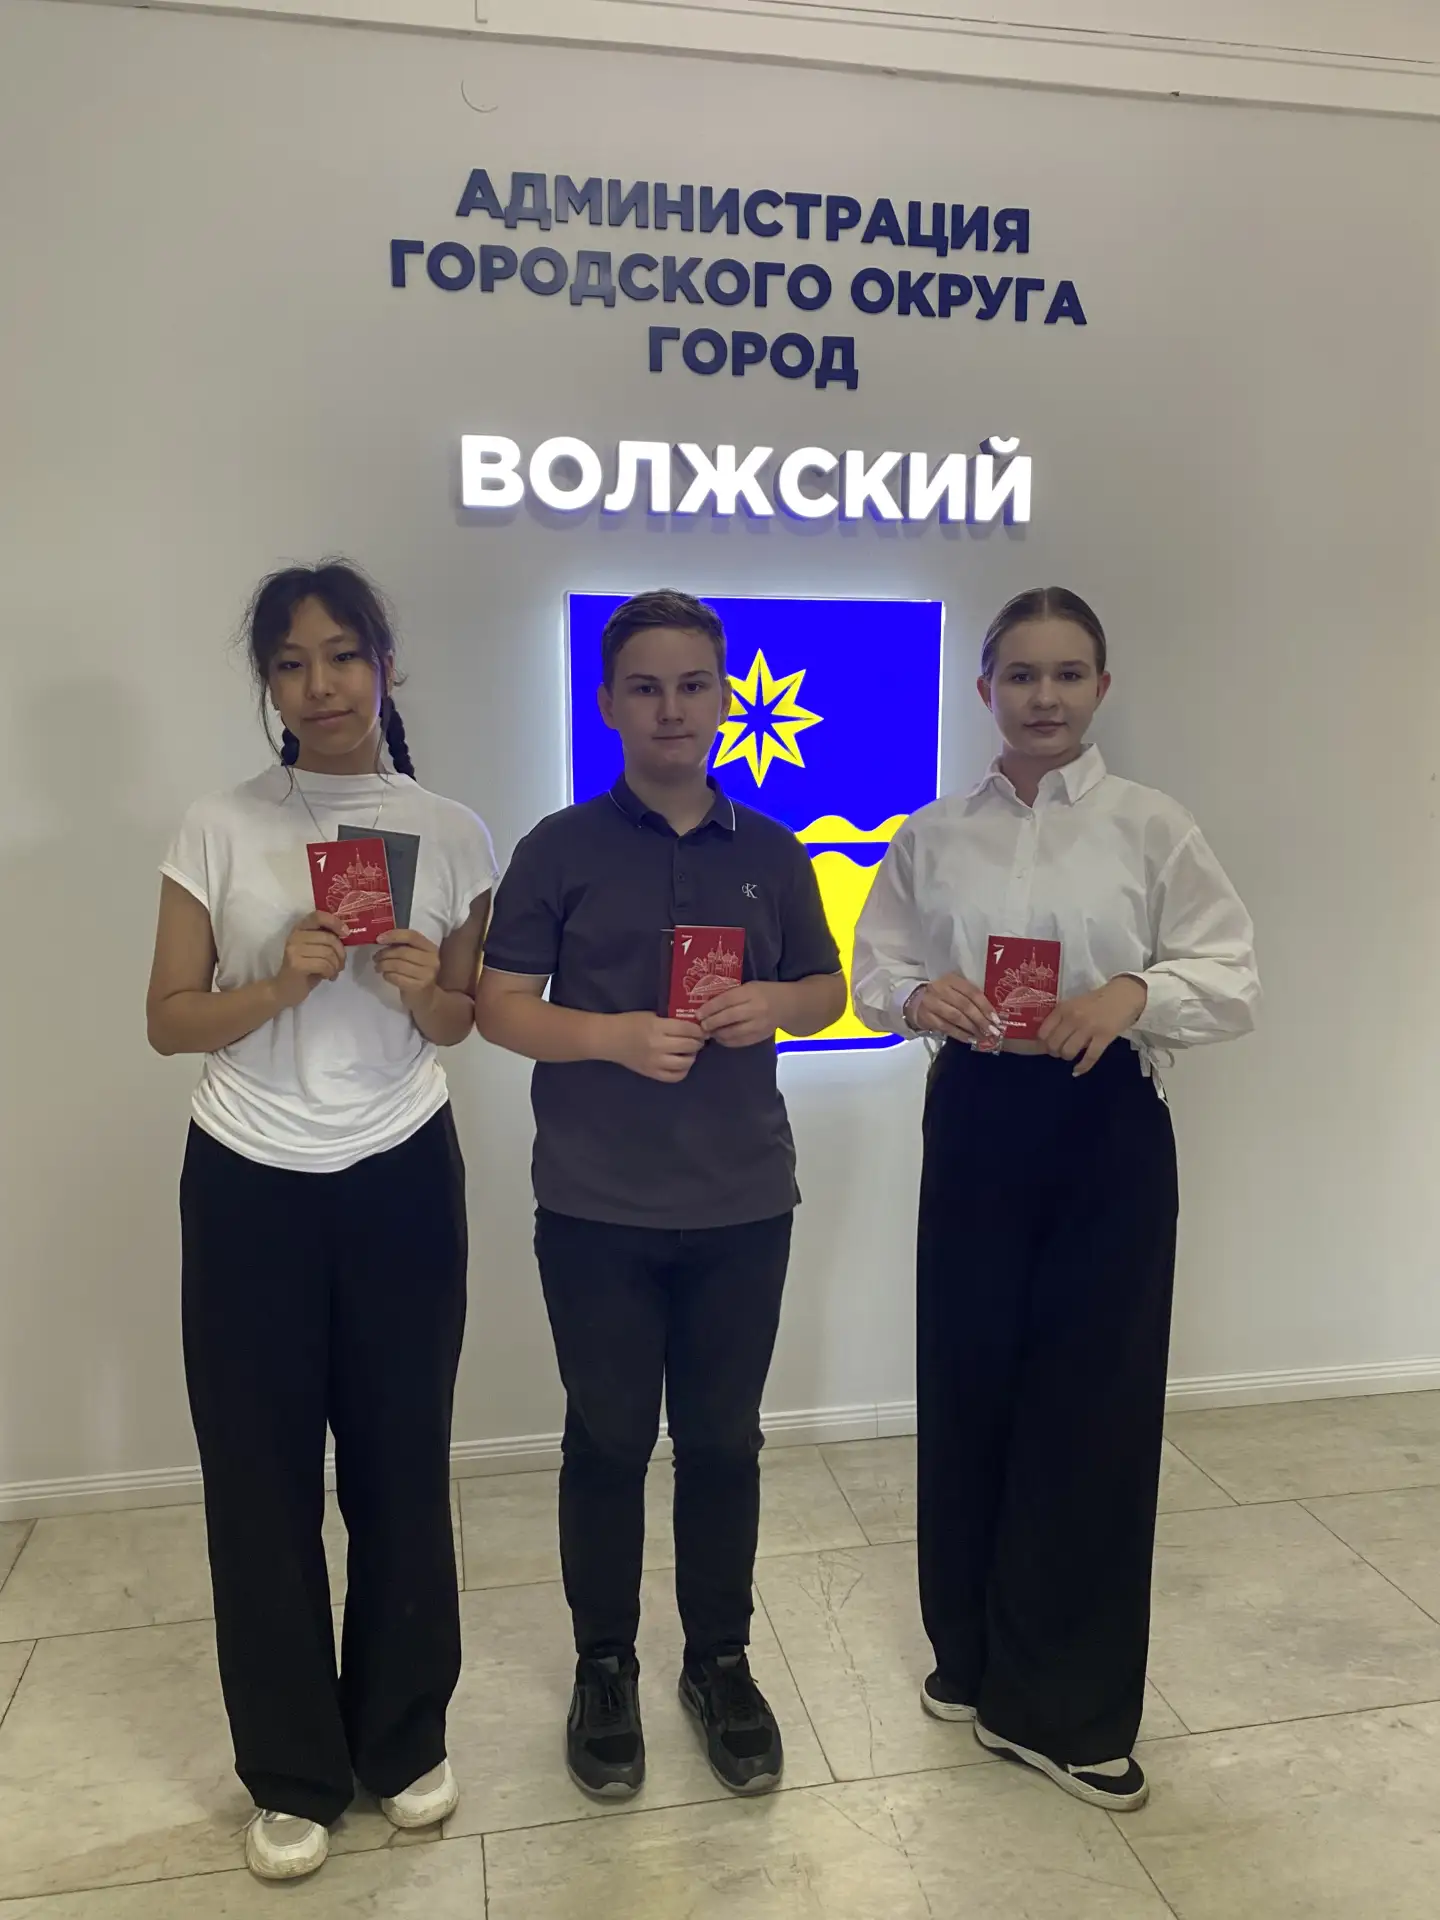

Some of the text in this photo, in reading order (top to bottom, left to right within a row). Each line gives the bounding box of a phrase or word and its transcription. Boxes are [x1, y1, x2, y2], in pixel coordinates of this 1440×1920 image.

[456, 168, 1031, 256] АДМИНИСТРАЦИЯ
[391, 239, 1088, 325] ГОРОДСКОГО ОКРУГА
[649, 325, 859, 390] ГОРОД
[460, 433, 1034, 524] ВОЛЖСКИЙ
